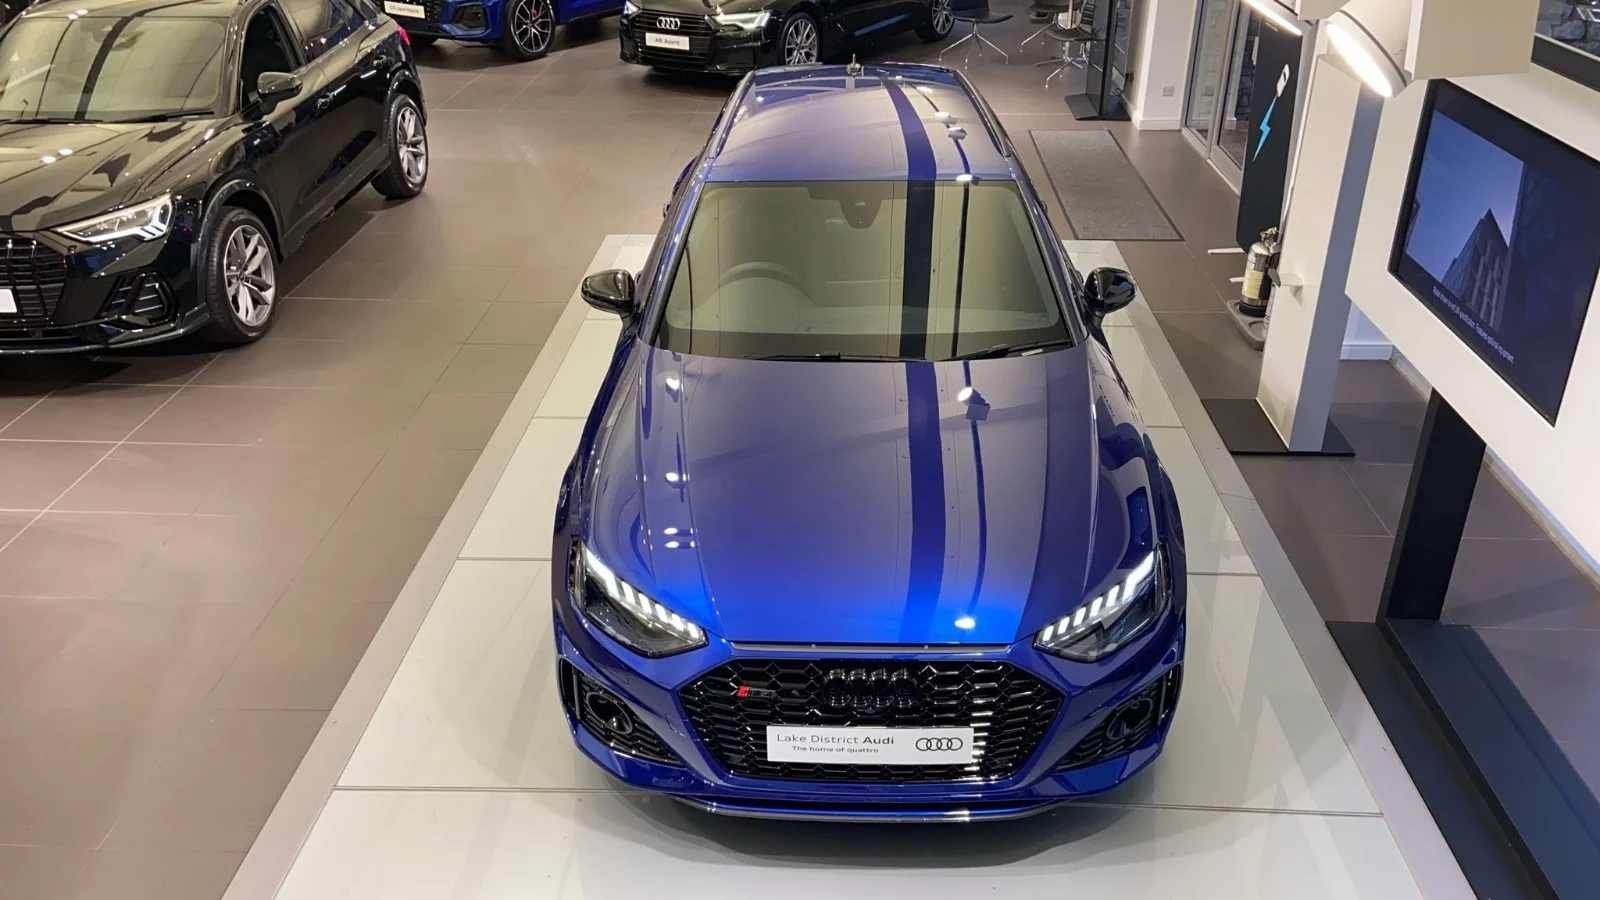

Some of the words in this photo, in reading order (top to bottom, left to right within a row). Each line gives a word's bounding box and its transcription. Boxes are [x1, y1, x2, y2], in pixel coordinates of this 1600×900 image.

[664, 38, 680, 46] Avant
[776, 733, 807, 743] Lake
[811, 734, 859, 744] District
[862, 736, 895, 745] Audi
